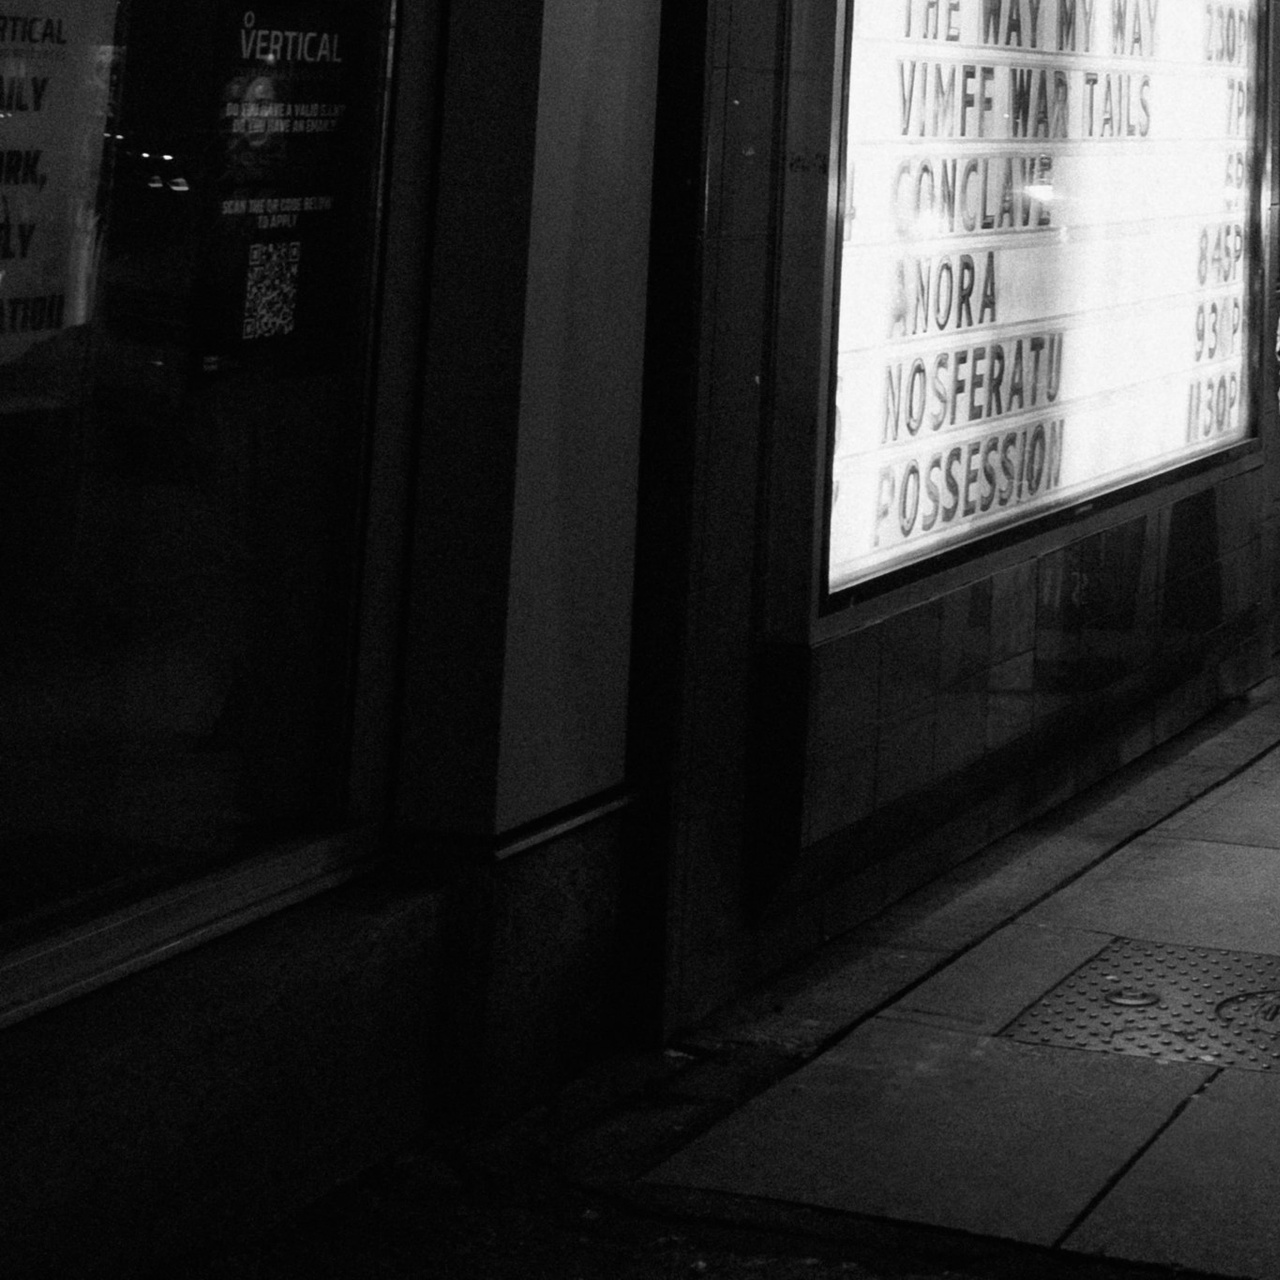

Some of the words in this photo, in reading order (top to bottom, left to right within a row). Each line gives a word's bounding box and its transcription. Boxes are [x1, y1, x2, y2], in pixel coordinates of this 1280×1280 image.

[240, 28, 343, 63] VERTICAL
[0, 74, 50, 112] ILY
[898, 60, 995, 138] VIMFF
[1010, 68, 1070, 139] WAR
[1085, 73, 1151, 138] TAILS
[892, 154, 1052, 236] CONCLAVE
[887, 251, 997, 339] ANORA
[1198, 224, 1243, 287] 845P
[882, 332, 1064, 444] NOSFERATU
[873, 418, 1065, 547] POSSESSION
